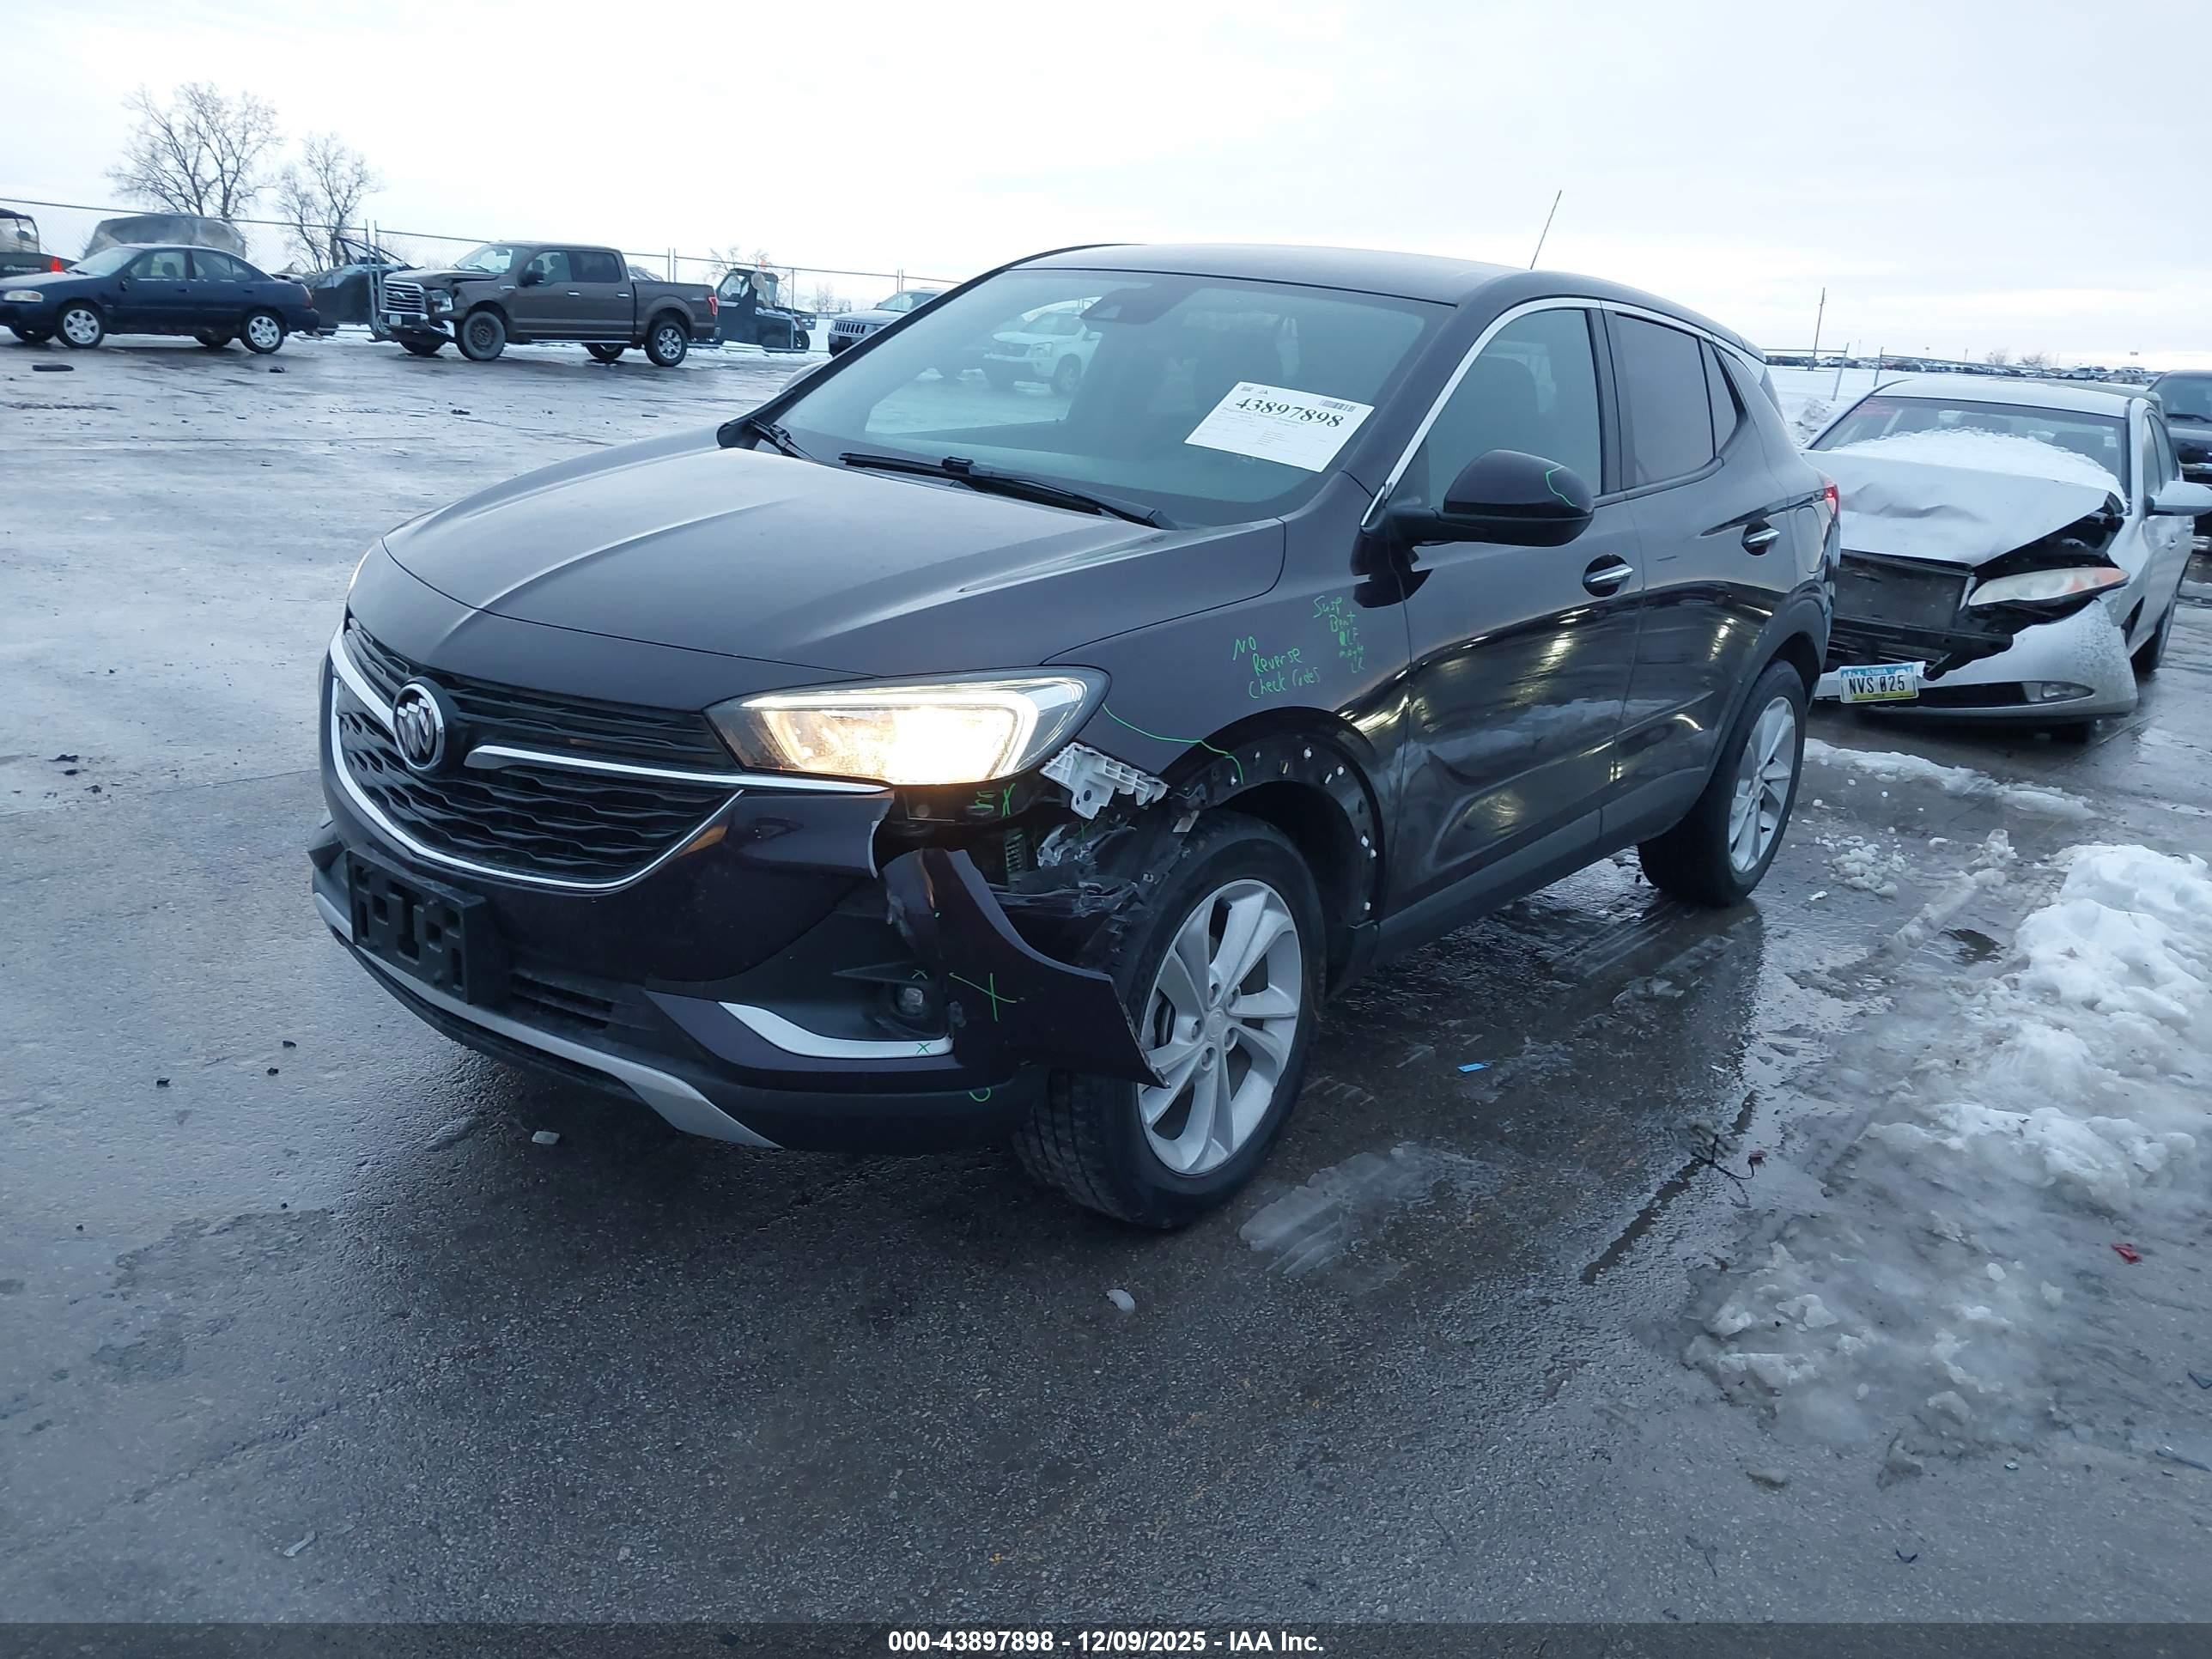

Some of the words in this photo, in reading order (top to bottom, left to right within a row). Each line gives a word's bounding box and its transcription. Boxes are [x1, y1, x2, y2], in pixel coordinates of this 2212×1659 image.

[1235, 398, 1345, 428] 43897898
[1232, 635, 1257, 660] NO
[1253, 648, 1303, 677] Reverse
[1249, 672, 1287, 699] Check
[1848, 677, 1875, 695] NVS
[1880, 674, 1905, 692] 025
